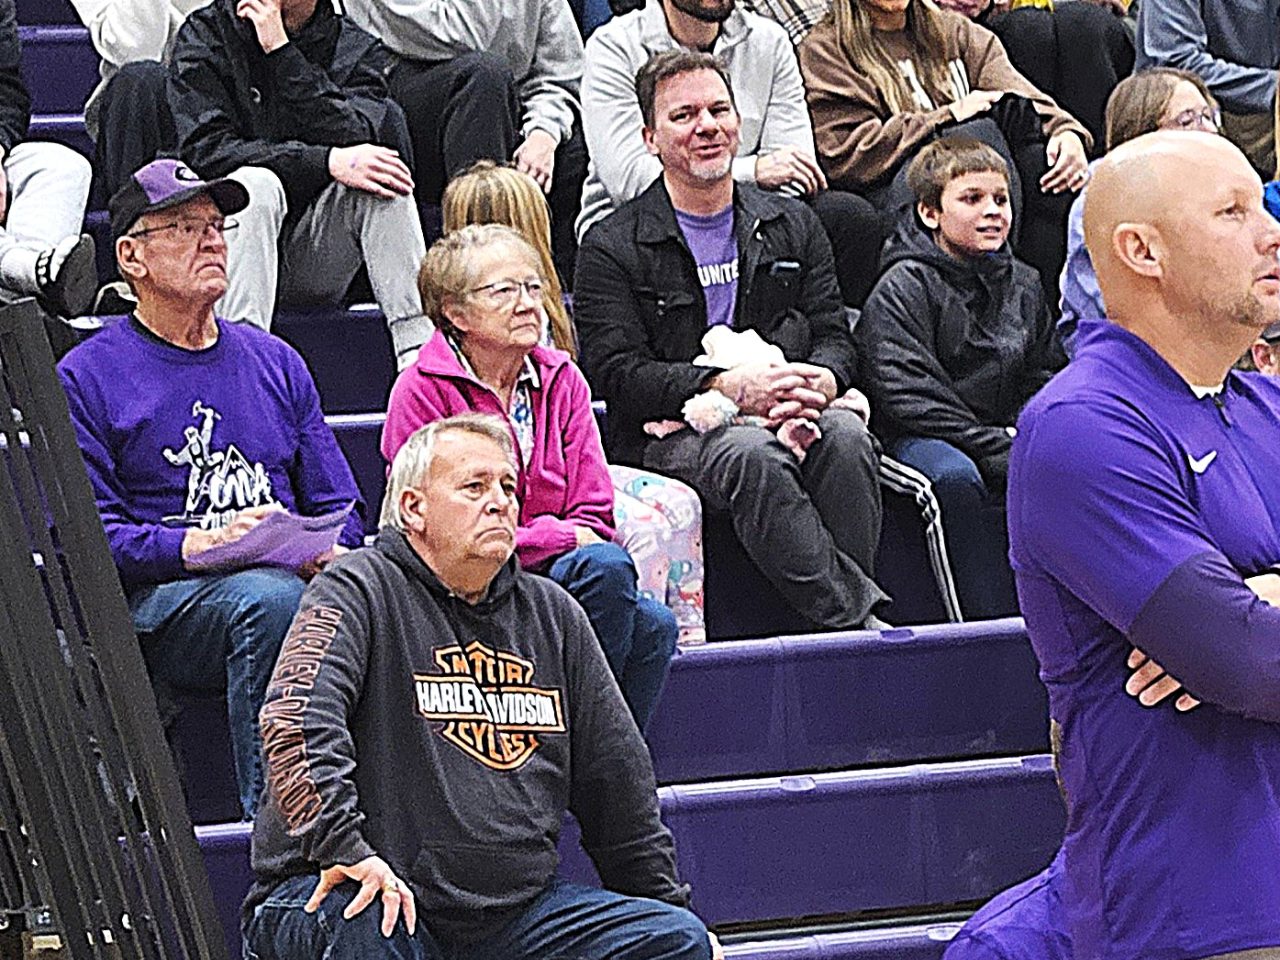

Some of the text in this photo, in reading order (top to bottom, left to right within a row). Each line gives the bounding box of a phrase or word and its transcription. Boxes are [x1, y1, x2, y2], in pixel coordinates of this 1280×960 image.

[451, 651, 523, 684] MTOR
[416, 681, 557, 726] HARLEAVIDSON
[458, 721, 526, 762] CYLES
